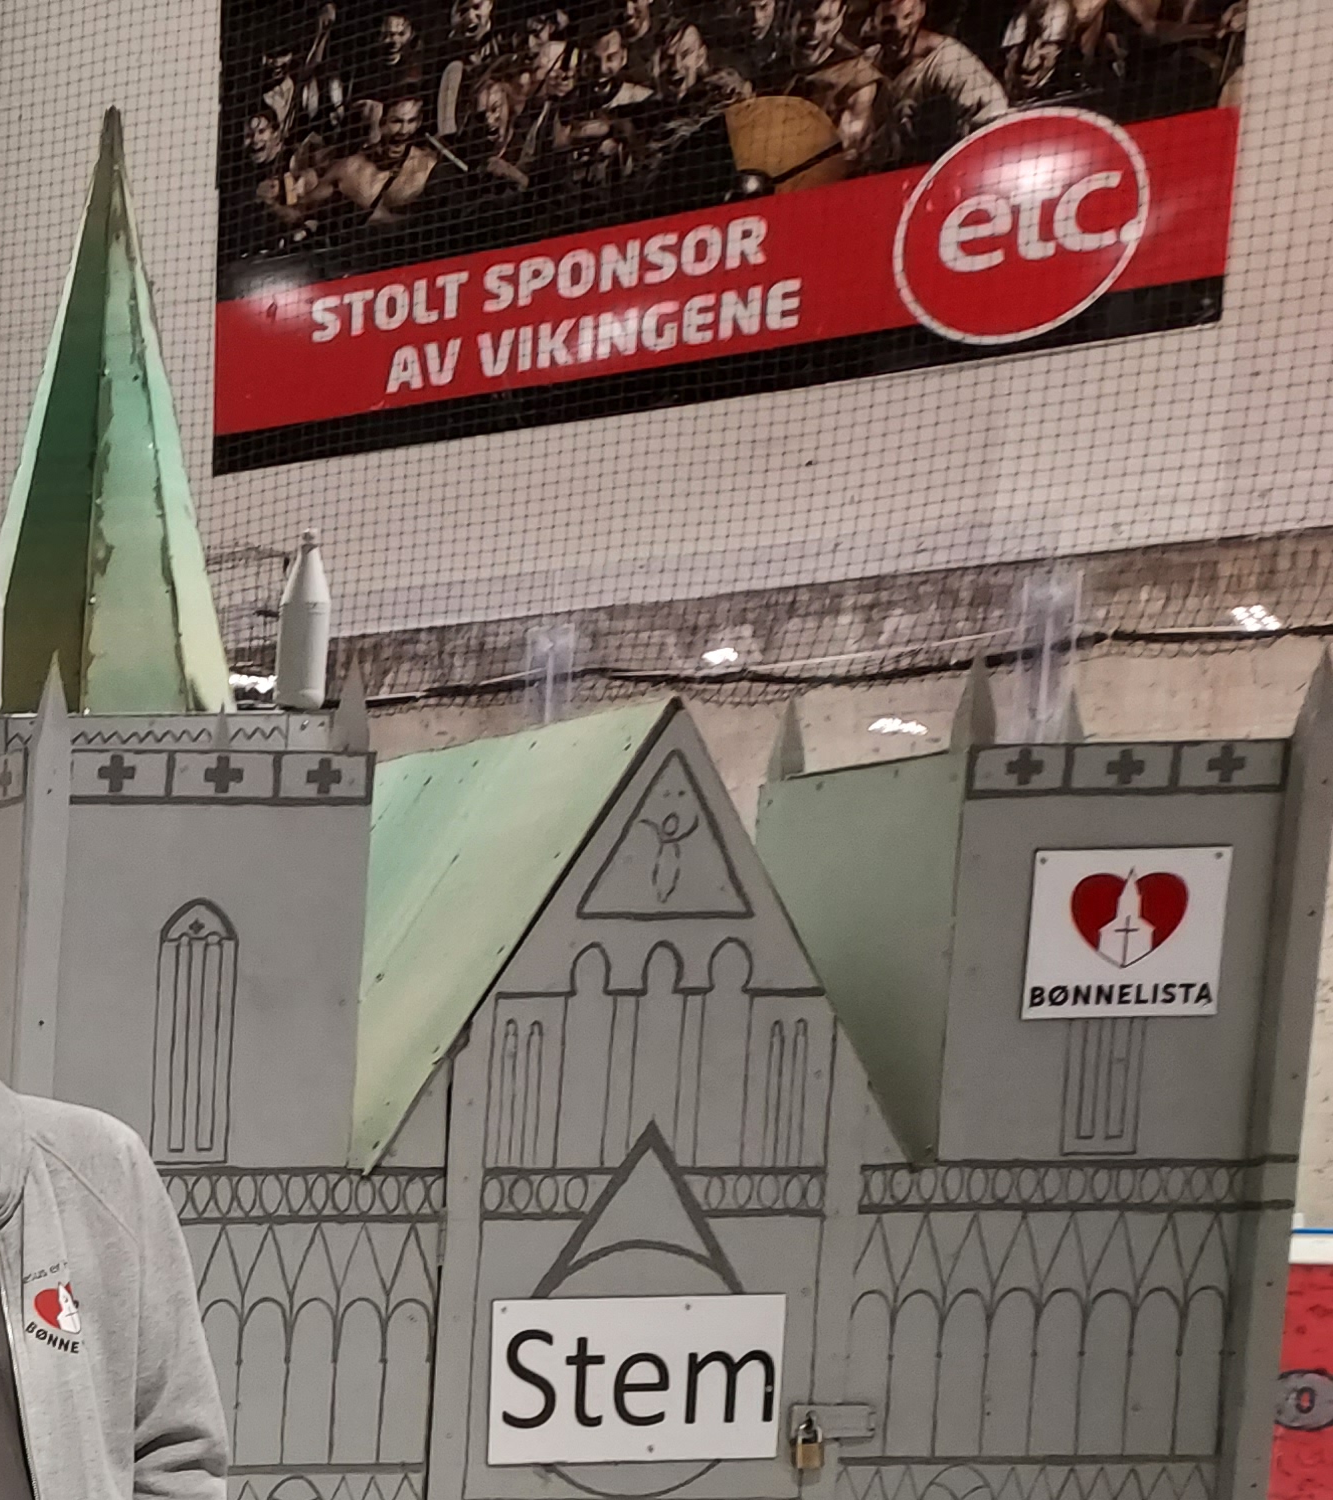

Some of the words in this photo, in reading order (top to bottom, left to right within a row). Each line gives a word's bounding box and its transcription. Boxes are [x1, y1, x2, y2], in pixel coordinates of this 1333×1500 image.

[310, 270, 469, 344] STOLT
[482, 214, 769, 313] SPONSOR
[385, 338, 462, 394] AV
[476, 278, 803, 379] VIKINGENE
[1028, 982, 1214, 1009] BØNNELISTA
[25, 1321, 80, 1354] BØNNE
[501, 1328, 775, 1429] Stem
